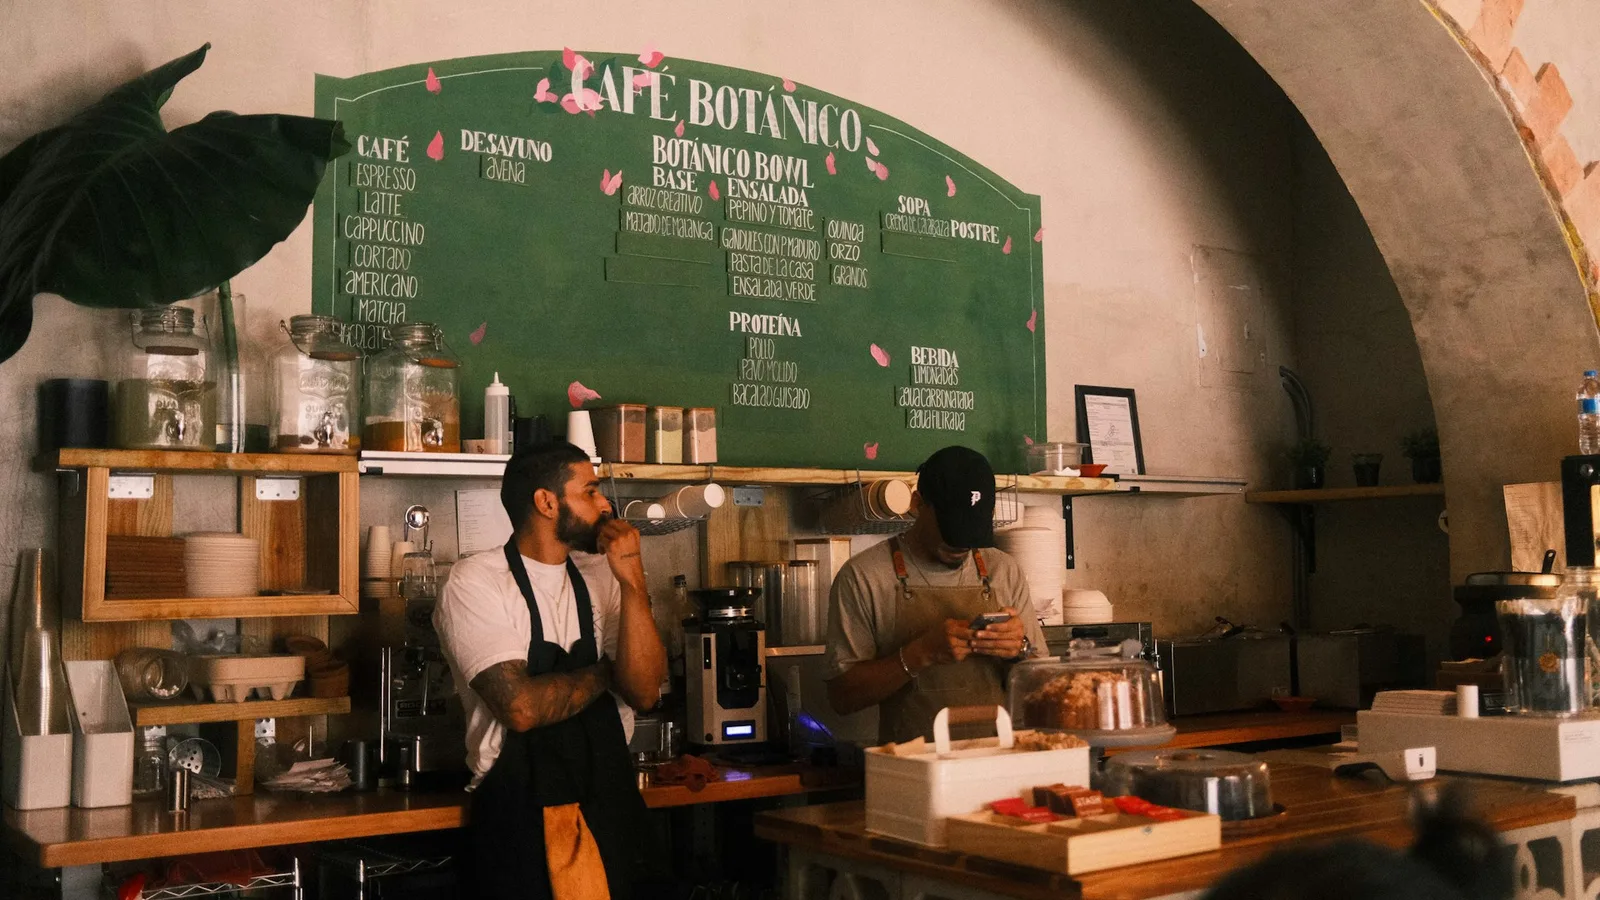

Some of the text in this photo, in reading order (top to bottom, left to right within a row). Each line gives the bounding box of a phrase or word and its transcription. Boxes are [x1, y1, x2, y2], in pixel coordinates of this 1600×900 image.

[571, 60, 862, 152] CAFÉ BOTÁNICO
[357, 135, 410, 163] CAFÉ
[461, 129, 552, 162] DESAYUNO
[652, 134, 814, 188] BOTÁNICO BOWL
[356, 163, 416, 191] ESPRESSO
[653, 166, 698, 192] BASE
[727, 177, 809, 207] ENSALADA
[769, 204, 776, 224] Y
[898, 195, 931, 217] SOPA
[661, 216, 672, 236] DE
[951, 220, 1000, 244] POSTRE
[764, 233, 780, 255] CON
[830, 242, 861, 262] ORZO
[763, 257, 774, 276] DE
[784, 281, 816, 302] VERDE
[729, 311, 802, 337] PROTEÍNA
[749, 337, 775, 360] POLLO
[911, 346, 959, 368] BEBIDA
[766, 360, 797, 383] MOLIDO
